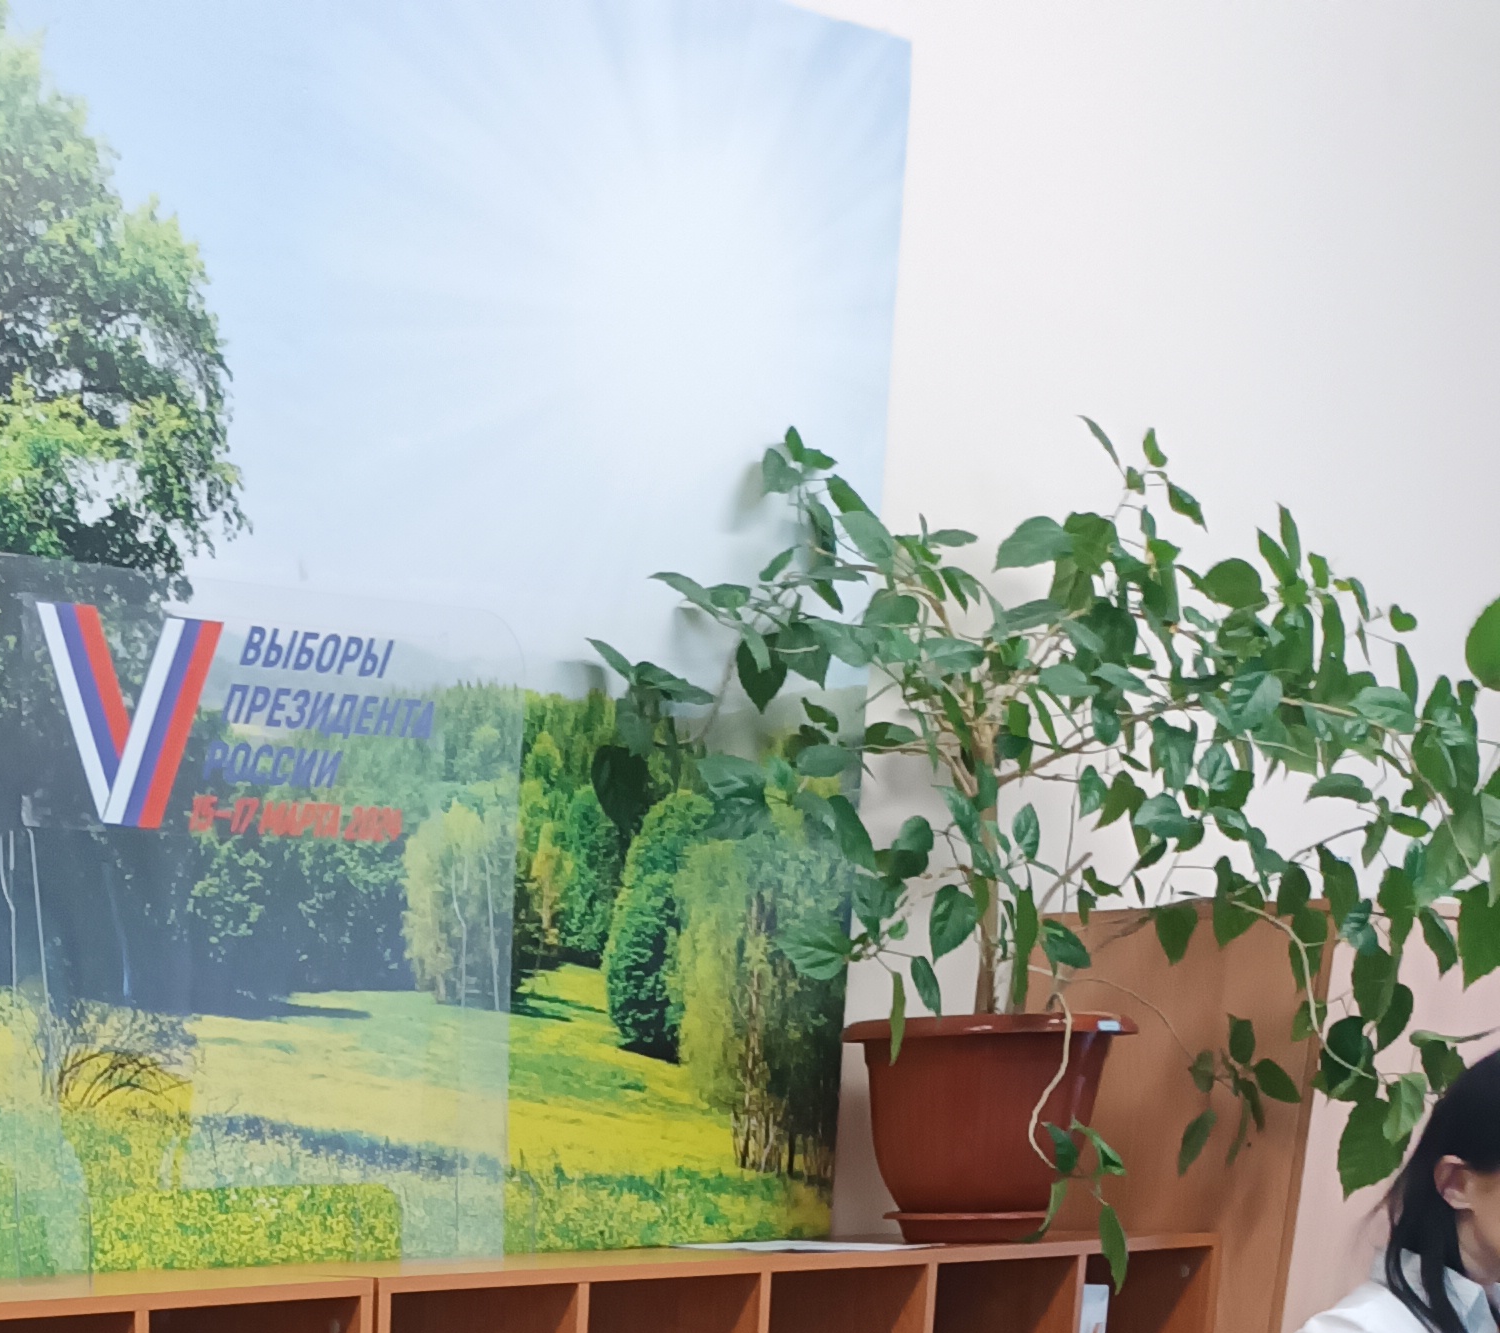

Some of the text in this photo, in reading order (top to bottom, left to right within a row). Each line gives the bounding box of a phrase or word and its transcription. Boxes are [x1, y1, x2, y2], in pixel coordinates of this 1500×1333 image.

[239, 625, 395, 679] ВЫБОРЫ
[222, 684, 435, 740] ПРЕЗИДЕНТА
[203, 740, 343, 789] РОССИИ
[258, 800, 342, 838] МАРТА
